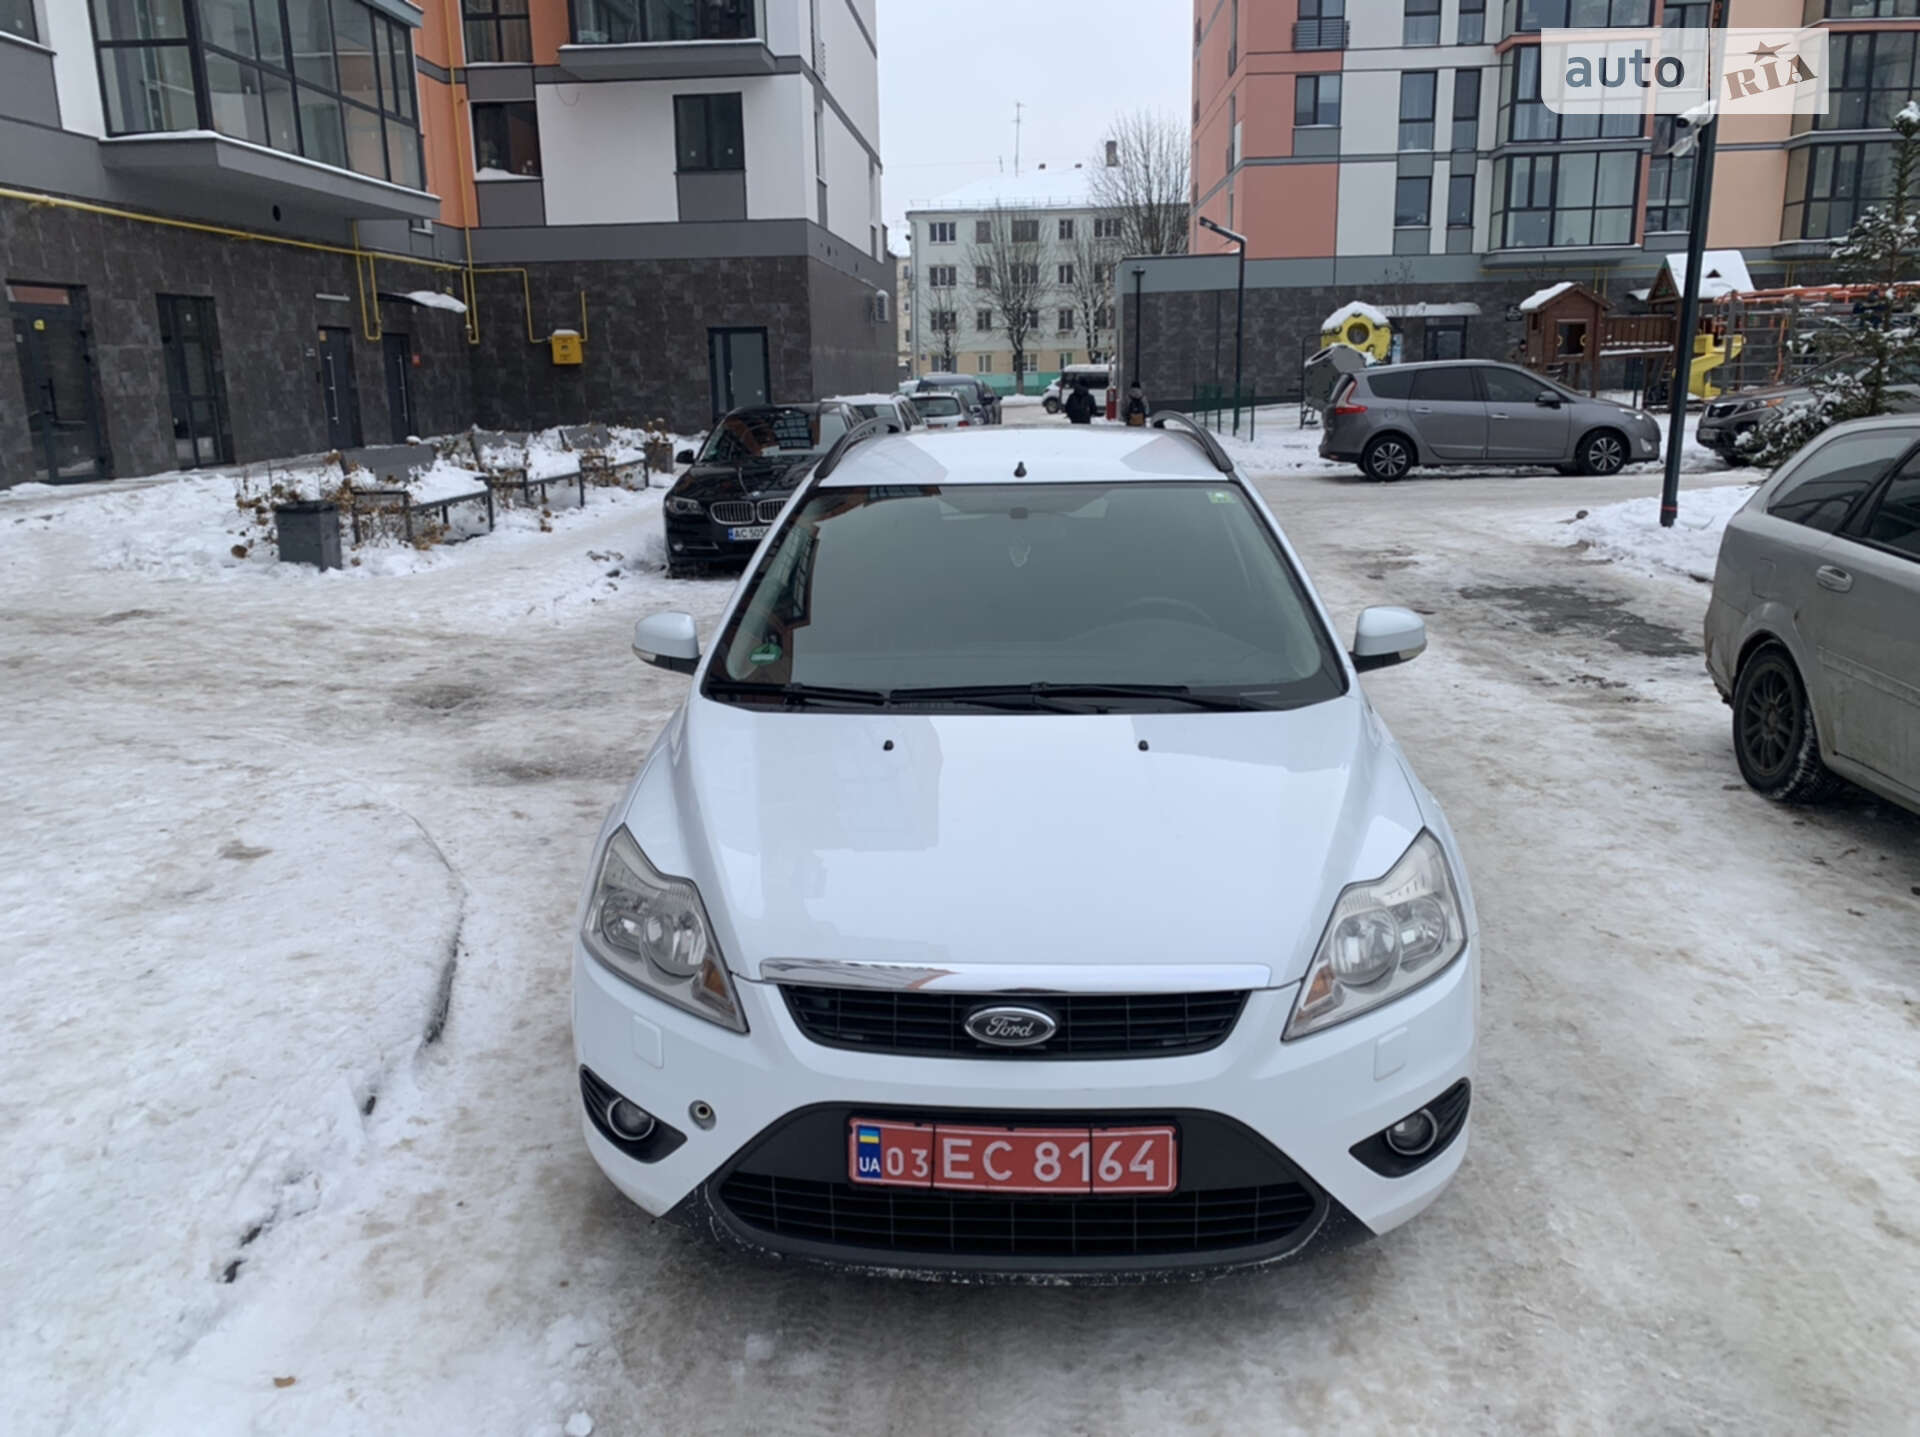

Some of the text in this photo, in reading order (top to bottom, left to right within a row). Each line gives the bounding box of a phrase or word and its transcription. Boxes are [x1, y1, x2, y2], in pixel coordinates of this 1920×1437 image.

[985, 1015, 1034, 1037] Ford
[859, 1156, 881, 1173] UA
[886, 1138, 1155, 1182] 03 EC 8164
